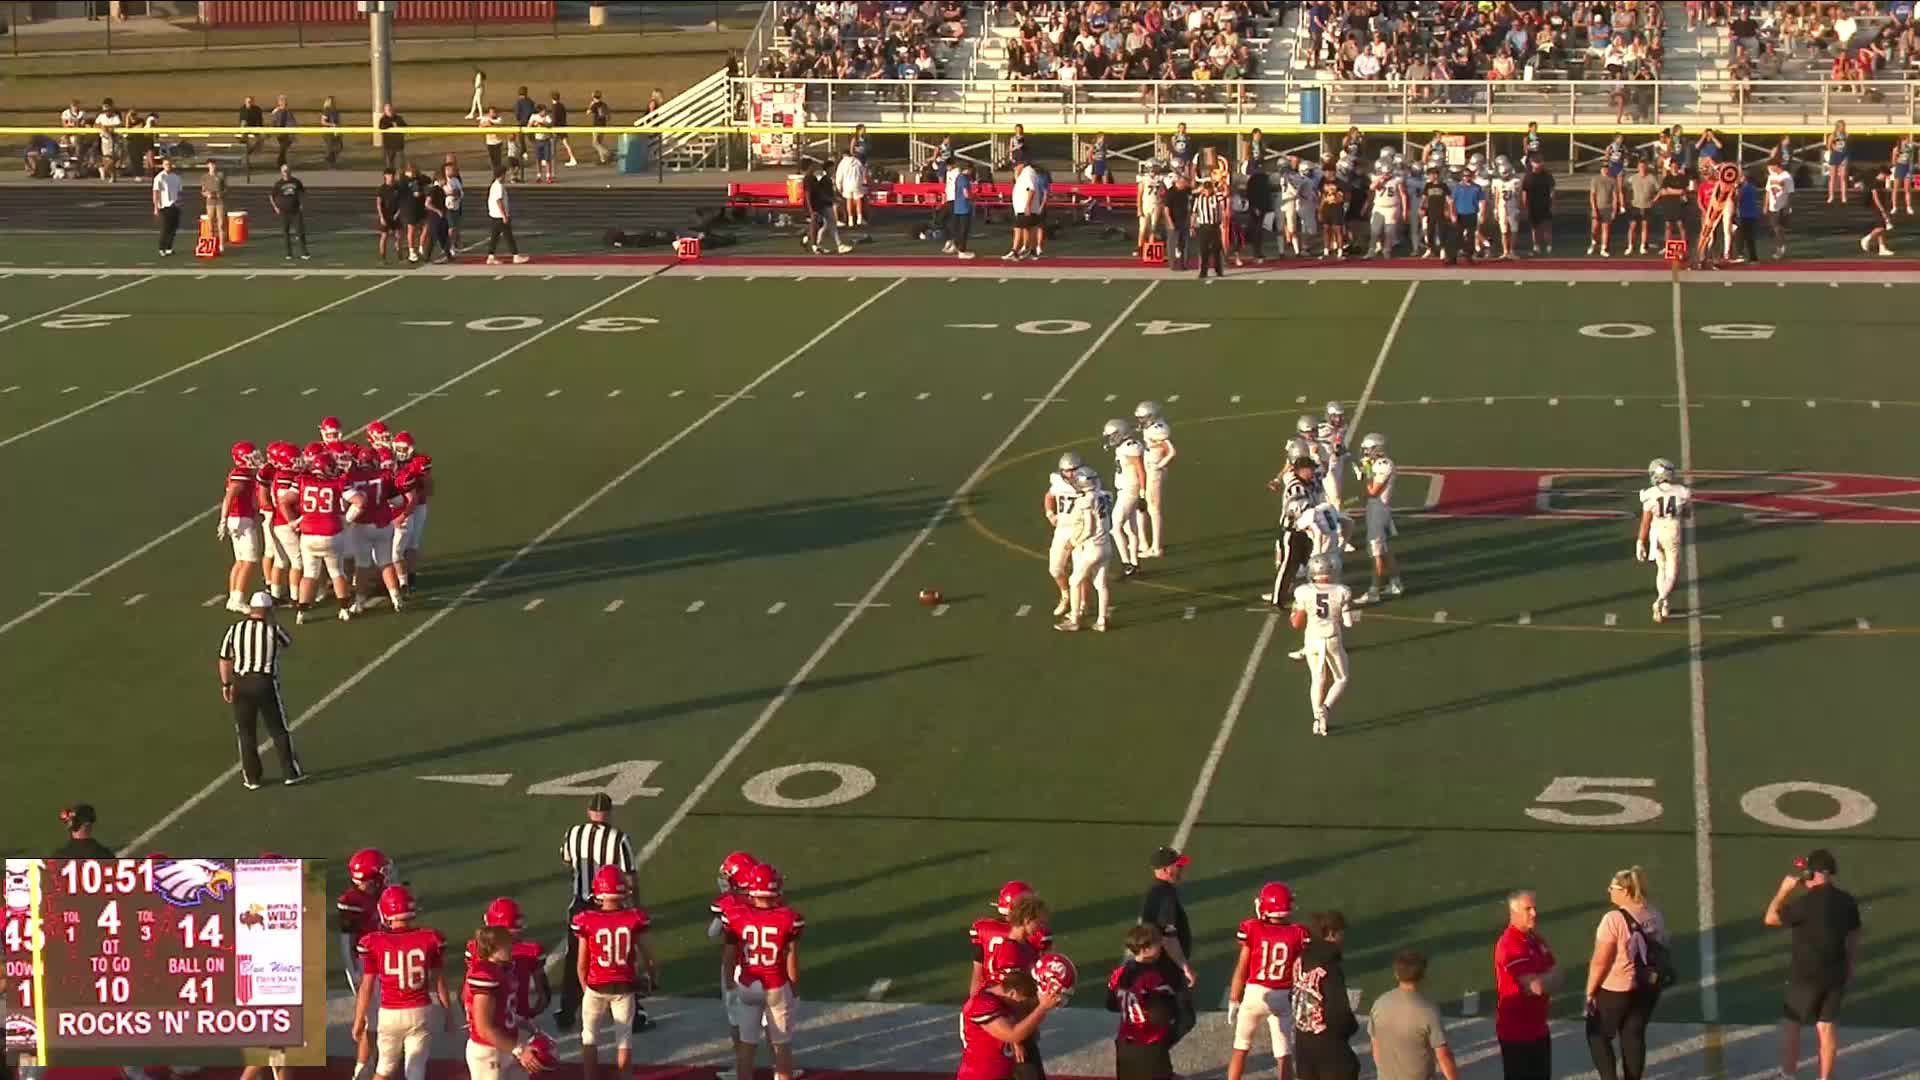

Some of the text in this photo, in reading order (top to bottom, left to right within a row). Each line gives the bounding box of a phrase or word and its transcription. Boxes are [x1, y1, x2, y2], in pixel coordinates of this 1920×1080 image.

[199, 238, 214, 253] 20
[680, 241, 697, 255] 30
[1146, 244, 1163, 260] 40
[302, 487, 334, 513] 53
[1058, 495, 1078, 514] 67
[1656, 495, 1677, 518] 14
[1316, 593, 1329, 618] 5
[61, 860, 153, 893] 10:51
[63, 901, 154, 934] TOL 4 TOL
[267, 911, 298, 921] WILD
[5, 917, 46, 951] 45
[66, 926, 152, 941] 1 3
[178, 914, 224, 948] 14
[102, 940, 119, 954] QT
[595, 927, 631, 967] 30
[742, 925, 779, 967] 25
[90, 957, 130, 971] TO GO
[168, 957, 225, 973] BALL ON
[383, 949, 425, 990] 46
[1256, 940, 1289, 981] 18
[18, 979, 32, 1007] 1
[94, 976, 130, 1003] 10
[179, 976, 214, 1004] 41
[58, 1009, 291, 1036] ROCKS 'N' ROOTS
